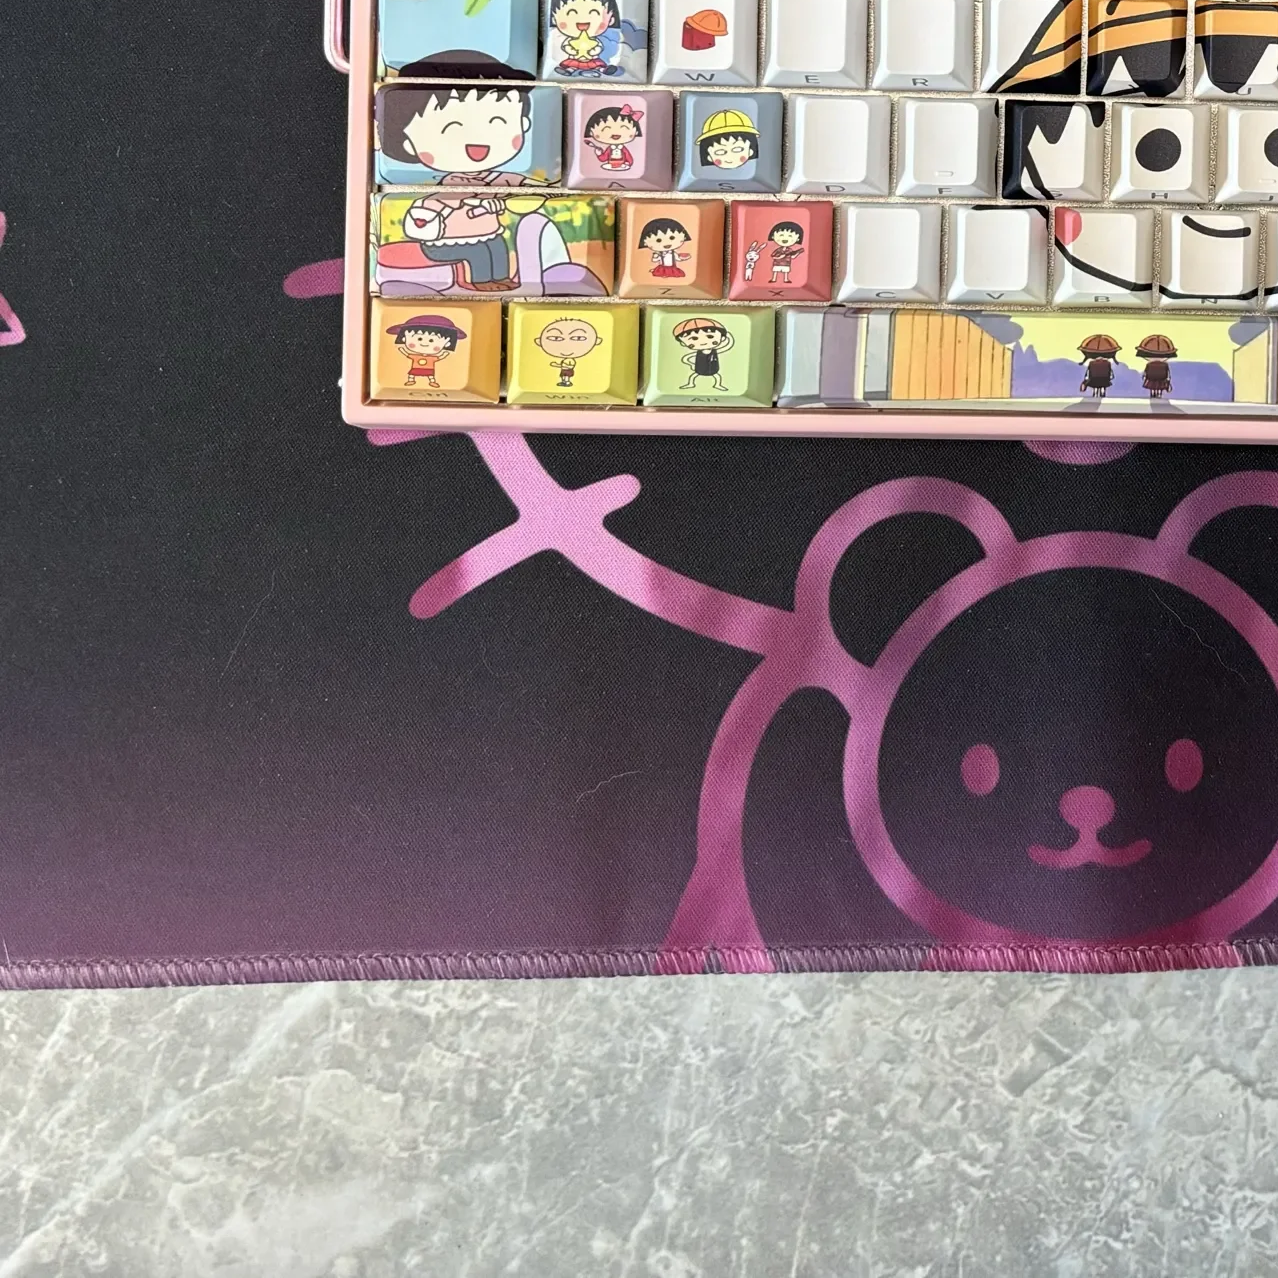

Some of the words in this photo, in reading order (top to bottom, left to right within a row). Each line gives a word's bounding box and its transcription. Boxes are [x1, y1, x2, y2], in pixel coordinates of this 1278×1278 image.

[684, 72, 715, 82] W
[805, 74, 820, 84] E
[911, 77, 930, 88] R
[607, 181, 627, 189] A
[717, 182, 735, 192] S
[824, 184, 845, 193] D
[937, 187, 953, 196] F
[1150, 191, 1169, 200] H
[659, 287, 675, 296] Z
[768, 290, 786, 298] X
[875, 291, 897, 299] C
[984, 292, 1005, 301] V
[1094, 295, 1111, 304] B
[545, 392, 589, 401] Win
